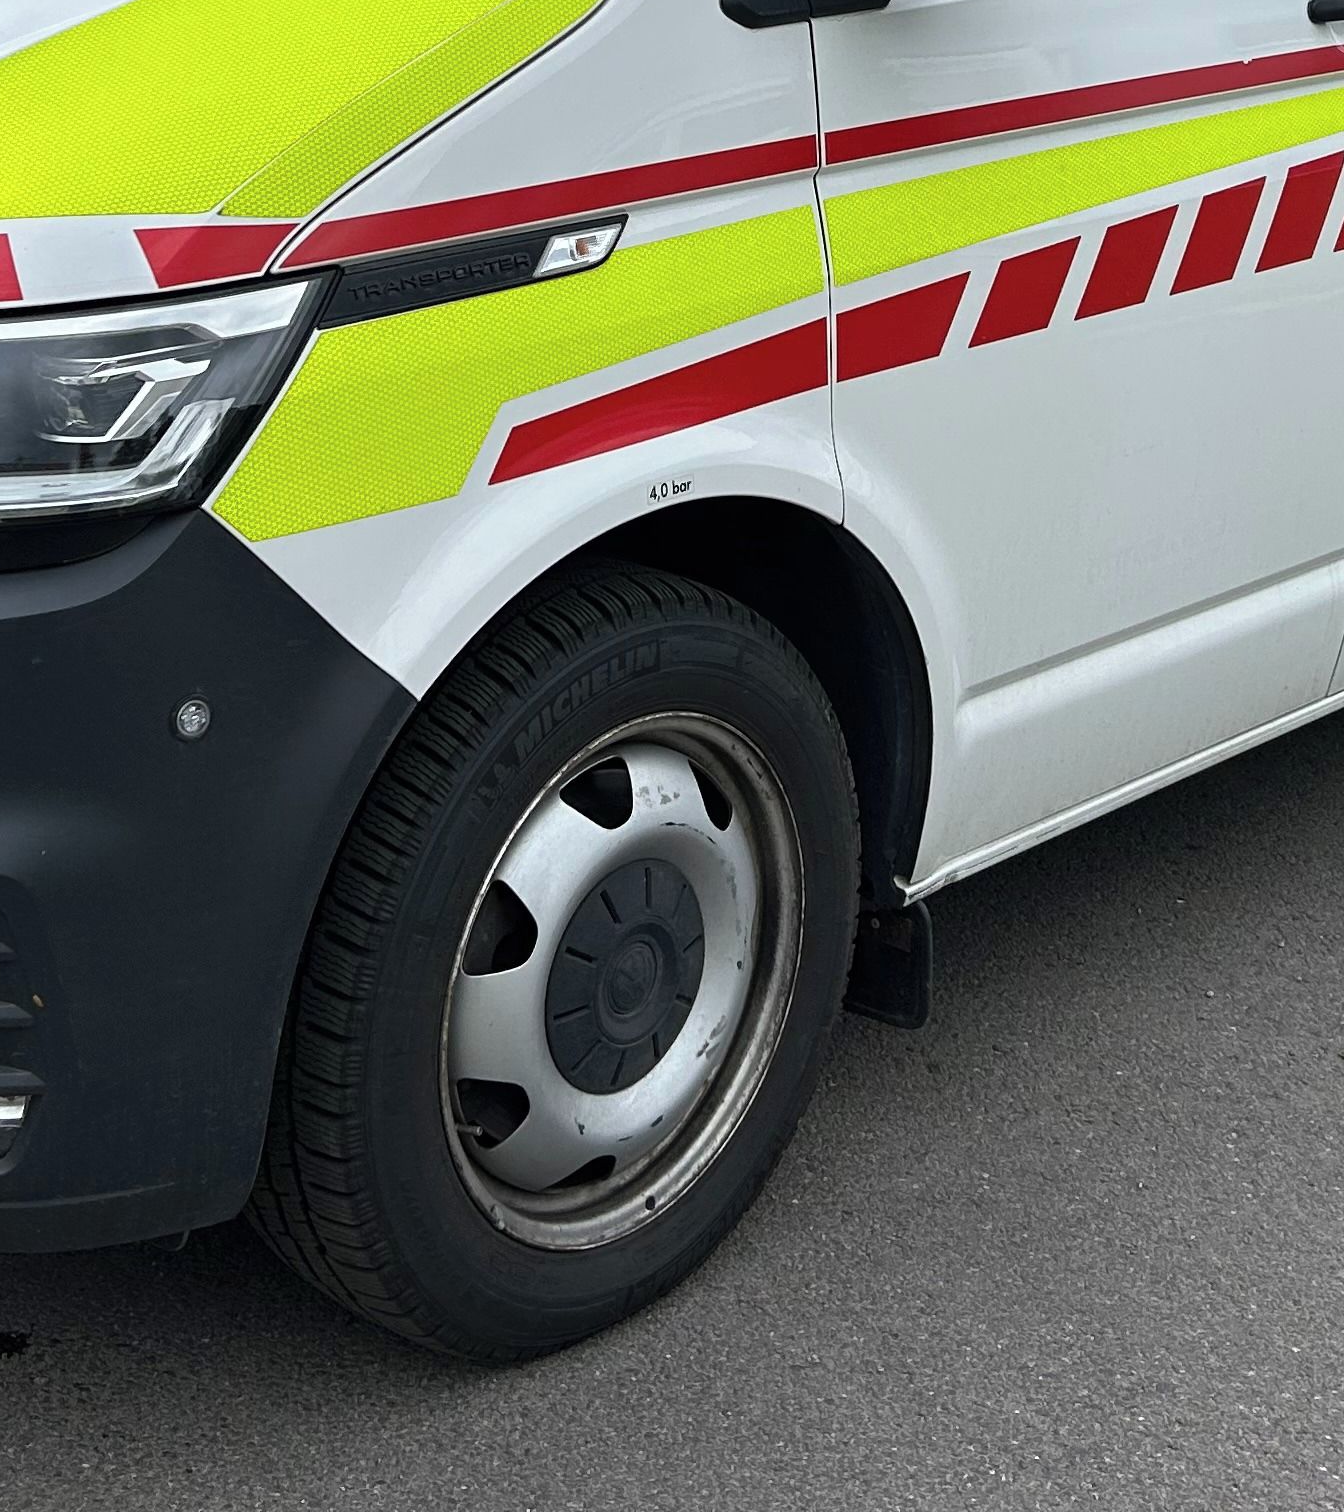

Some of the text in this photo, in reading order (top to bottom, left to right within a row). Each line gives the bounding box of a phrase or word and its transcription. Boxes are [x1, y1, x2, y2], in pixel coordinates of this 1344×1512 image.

[348, 254, 531, 301] TRANSPORTER
[649, 480, 692, 502] 4,0 bar
[513, 639, 661, 760] MICHELIN
